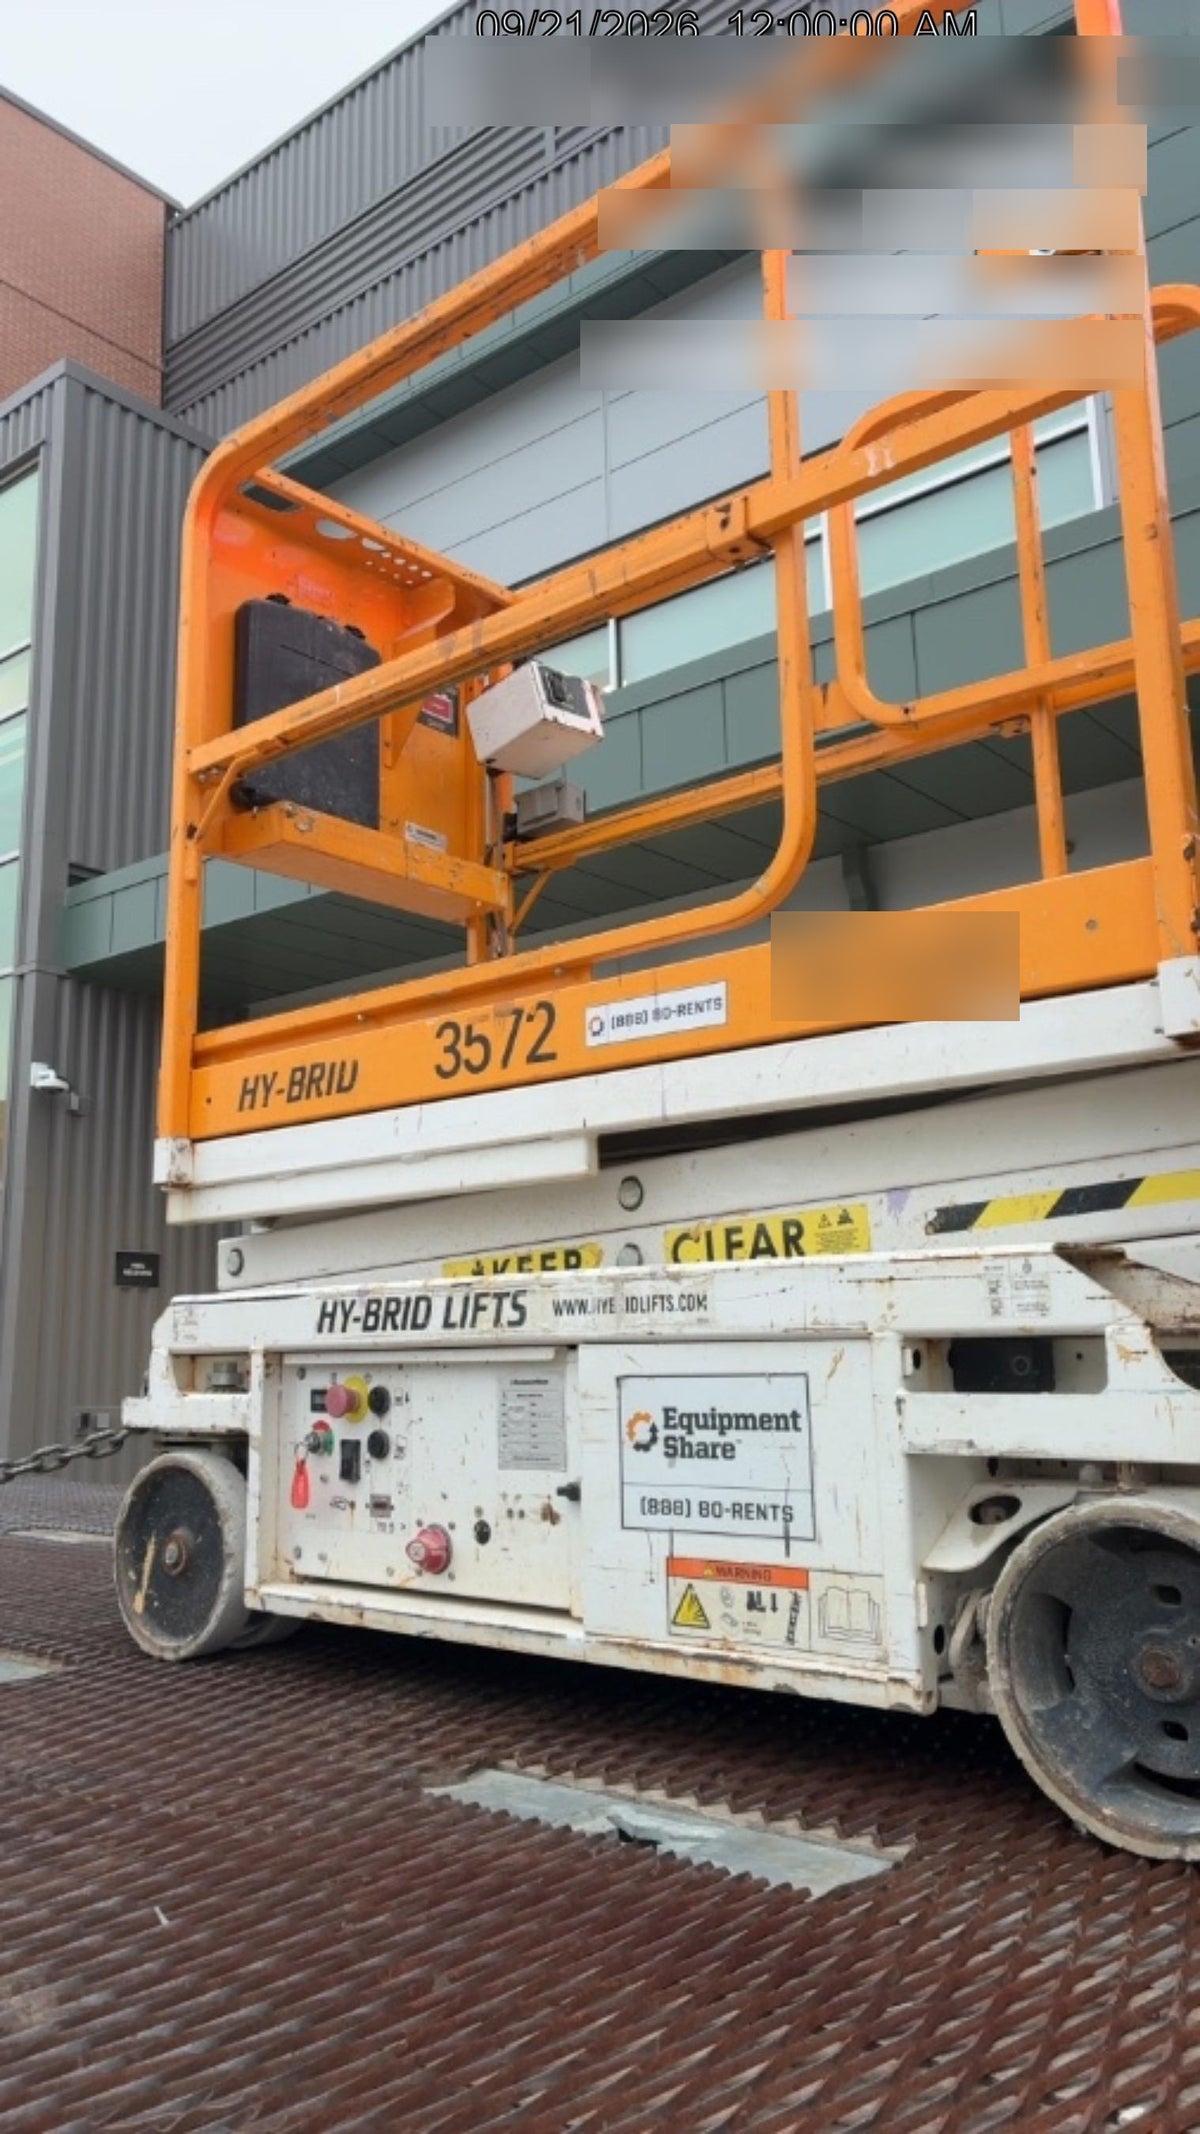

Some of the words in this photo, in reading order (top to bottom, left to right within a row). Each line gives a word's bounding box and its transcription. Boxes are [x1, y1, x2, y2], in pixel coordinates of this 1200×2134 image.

[434, 1000, 558, 1080] 3572
[237, 1059, 359, 1113] HY-BRID
[316, 1294, 433, 1334] HY-BRID
[442, 1289, 528, 1329] LIFTS
[662, 1406, 802, 1436] Equipment
[663, 1436, 736, 1460] Share
[640, 1496, 692, 1518] (888)
[698, 1500, 794, 1524] 80-RENTS
[715, 1565, 772, 1582] WARNING
